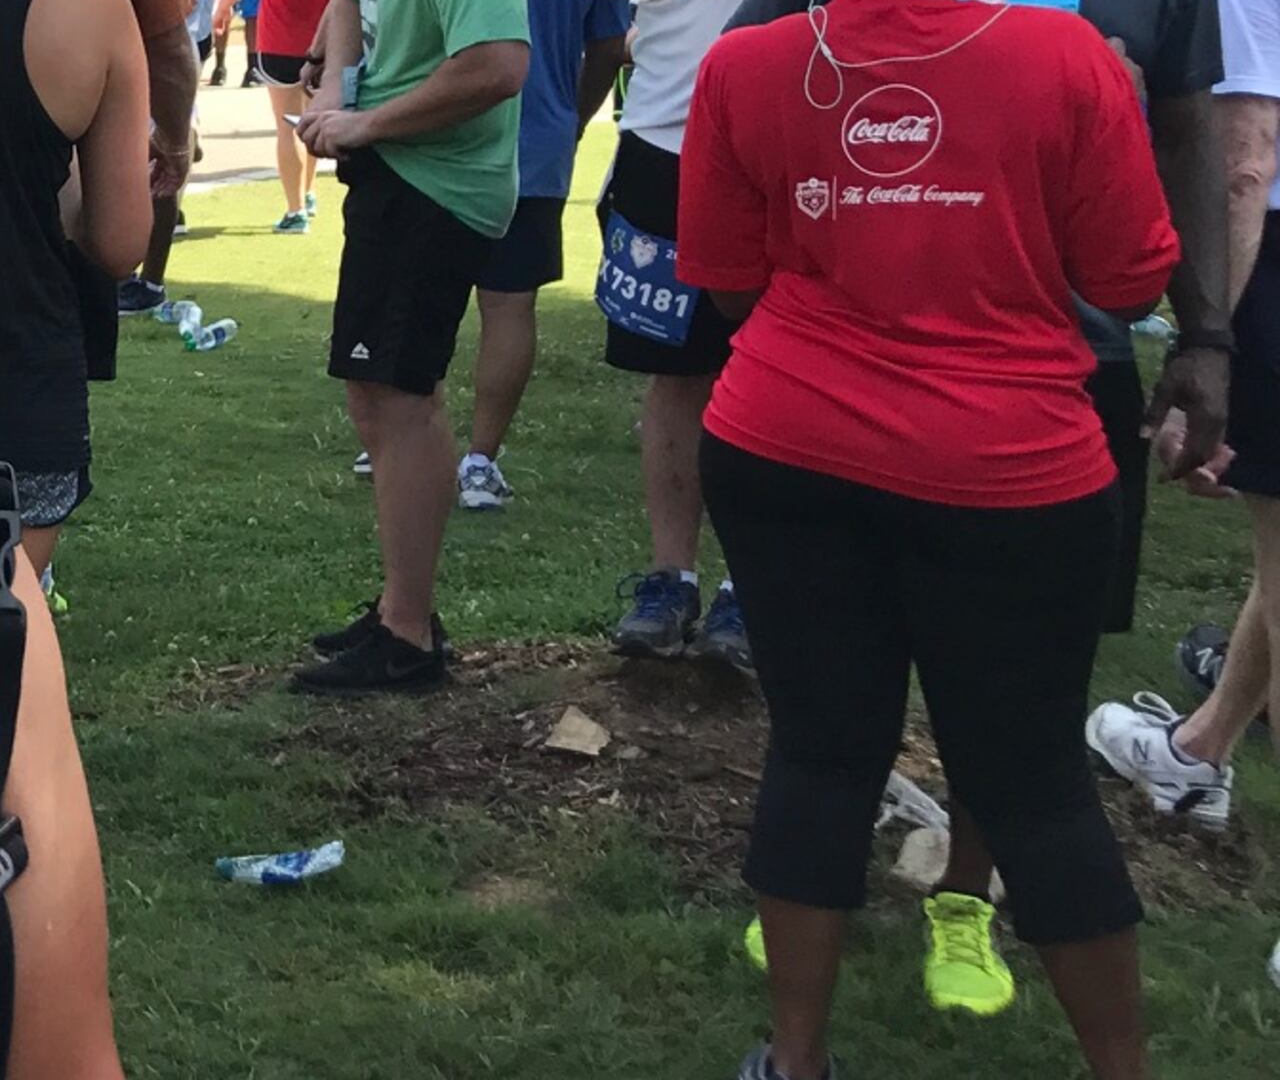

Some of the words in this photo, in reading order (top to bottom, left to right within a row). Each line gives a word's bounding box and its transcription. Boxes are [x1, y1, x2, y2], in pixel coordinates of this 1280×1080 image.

[840, 185, 865, 205] The
[923, 184, 986, 207] Company
[610, 265, 689, 318] 73181
